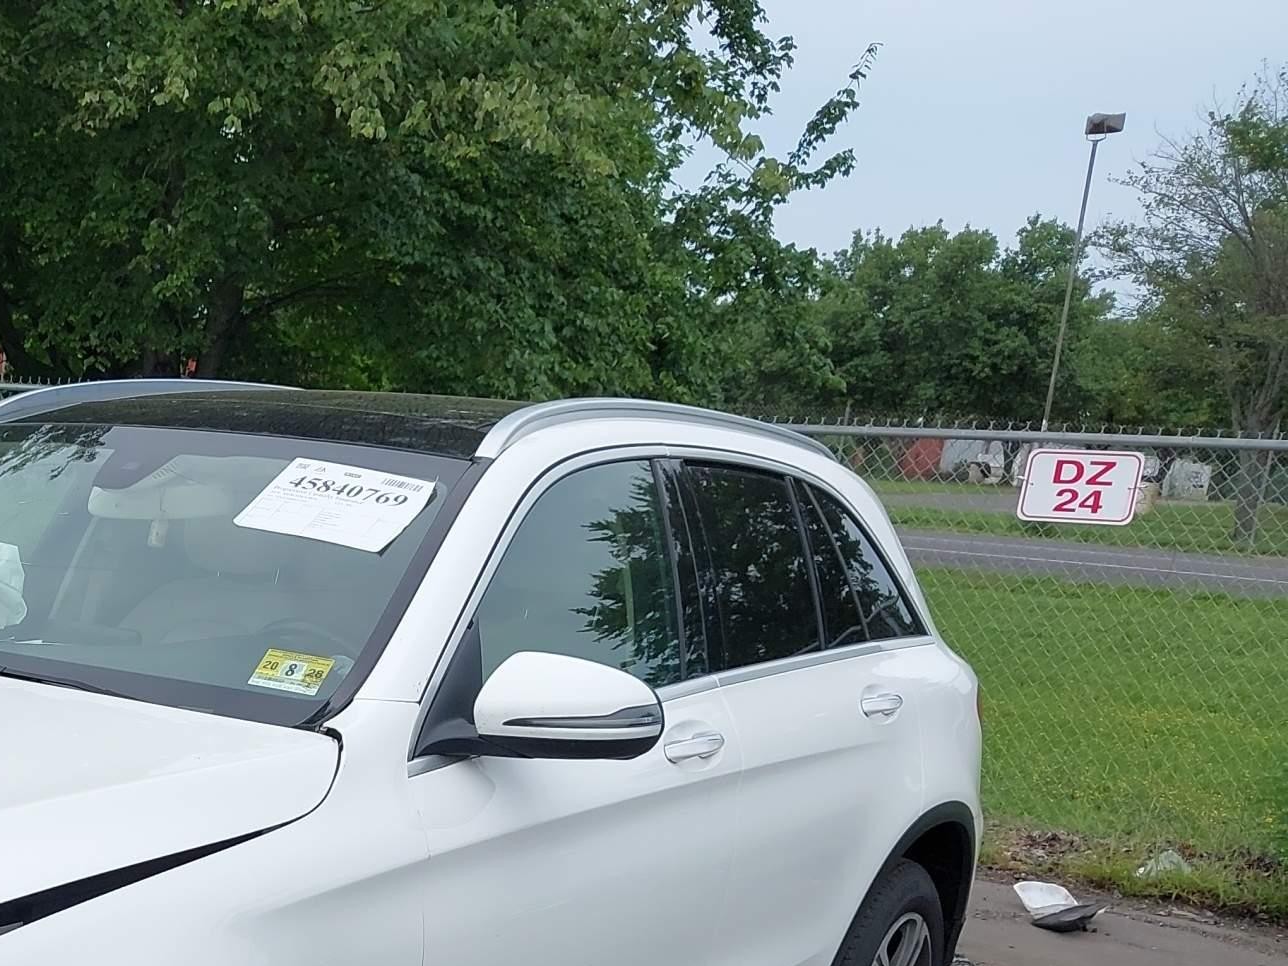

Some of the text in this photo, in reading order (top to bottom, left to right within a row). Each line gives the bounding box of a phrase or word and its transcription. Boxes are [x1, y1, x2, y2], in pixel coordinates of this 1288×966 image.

[1052, 459, 1117, 486] DZ
[289, 475, 409, 507] 45840769
[1052, 488, 1103, 514] 24
[262, 660, 280, 671] 20
[284, 663, 298, 677] 8
